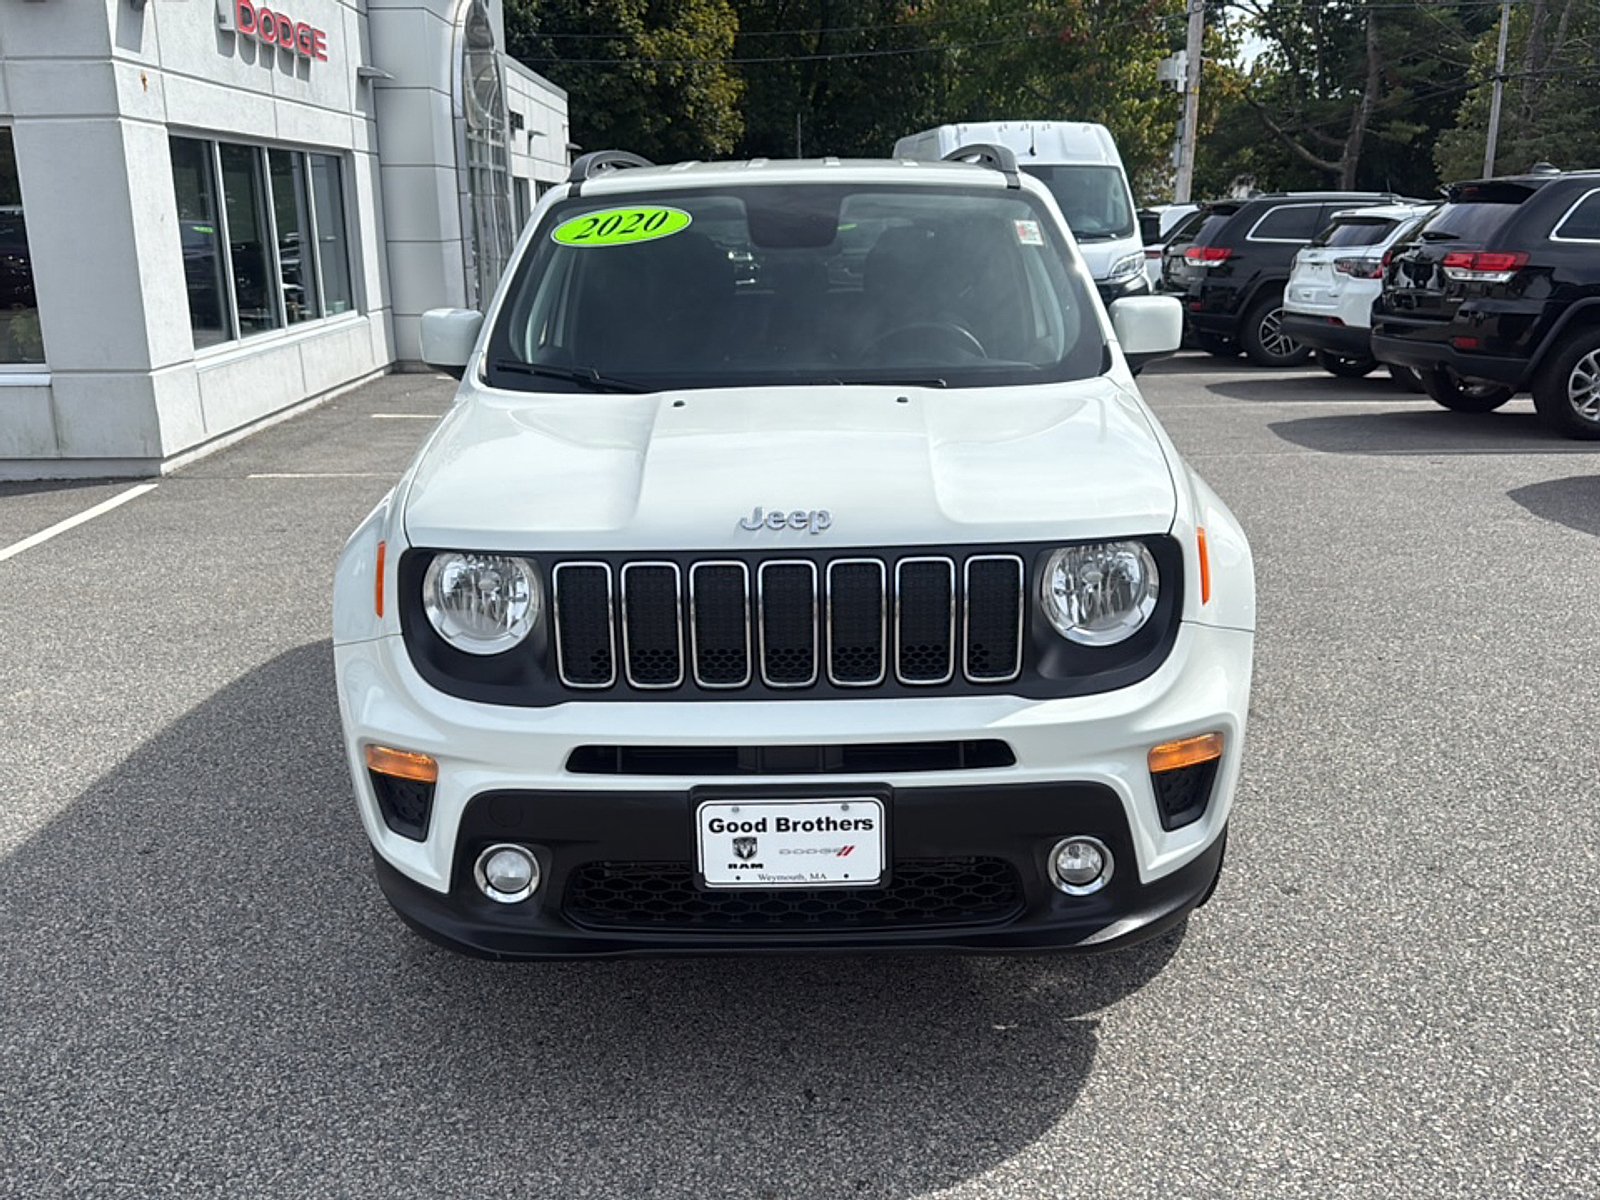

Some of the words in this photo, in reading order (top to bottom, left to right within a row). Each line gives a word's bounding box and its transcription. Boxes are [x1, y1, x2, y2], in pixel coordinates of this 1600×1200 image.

[236, 0, 328, 62] DODGE
[572, 210, 670, 240] 2020
[739, 506, 832, 535] Jeep
[708, 817, 767, 833] Good
[775, 816, 874, 833] Brothers
[728, 862, 764, 870] RAM
[810, 872, 827, 880] MA
